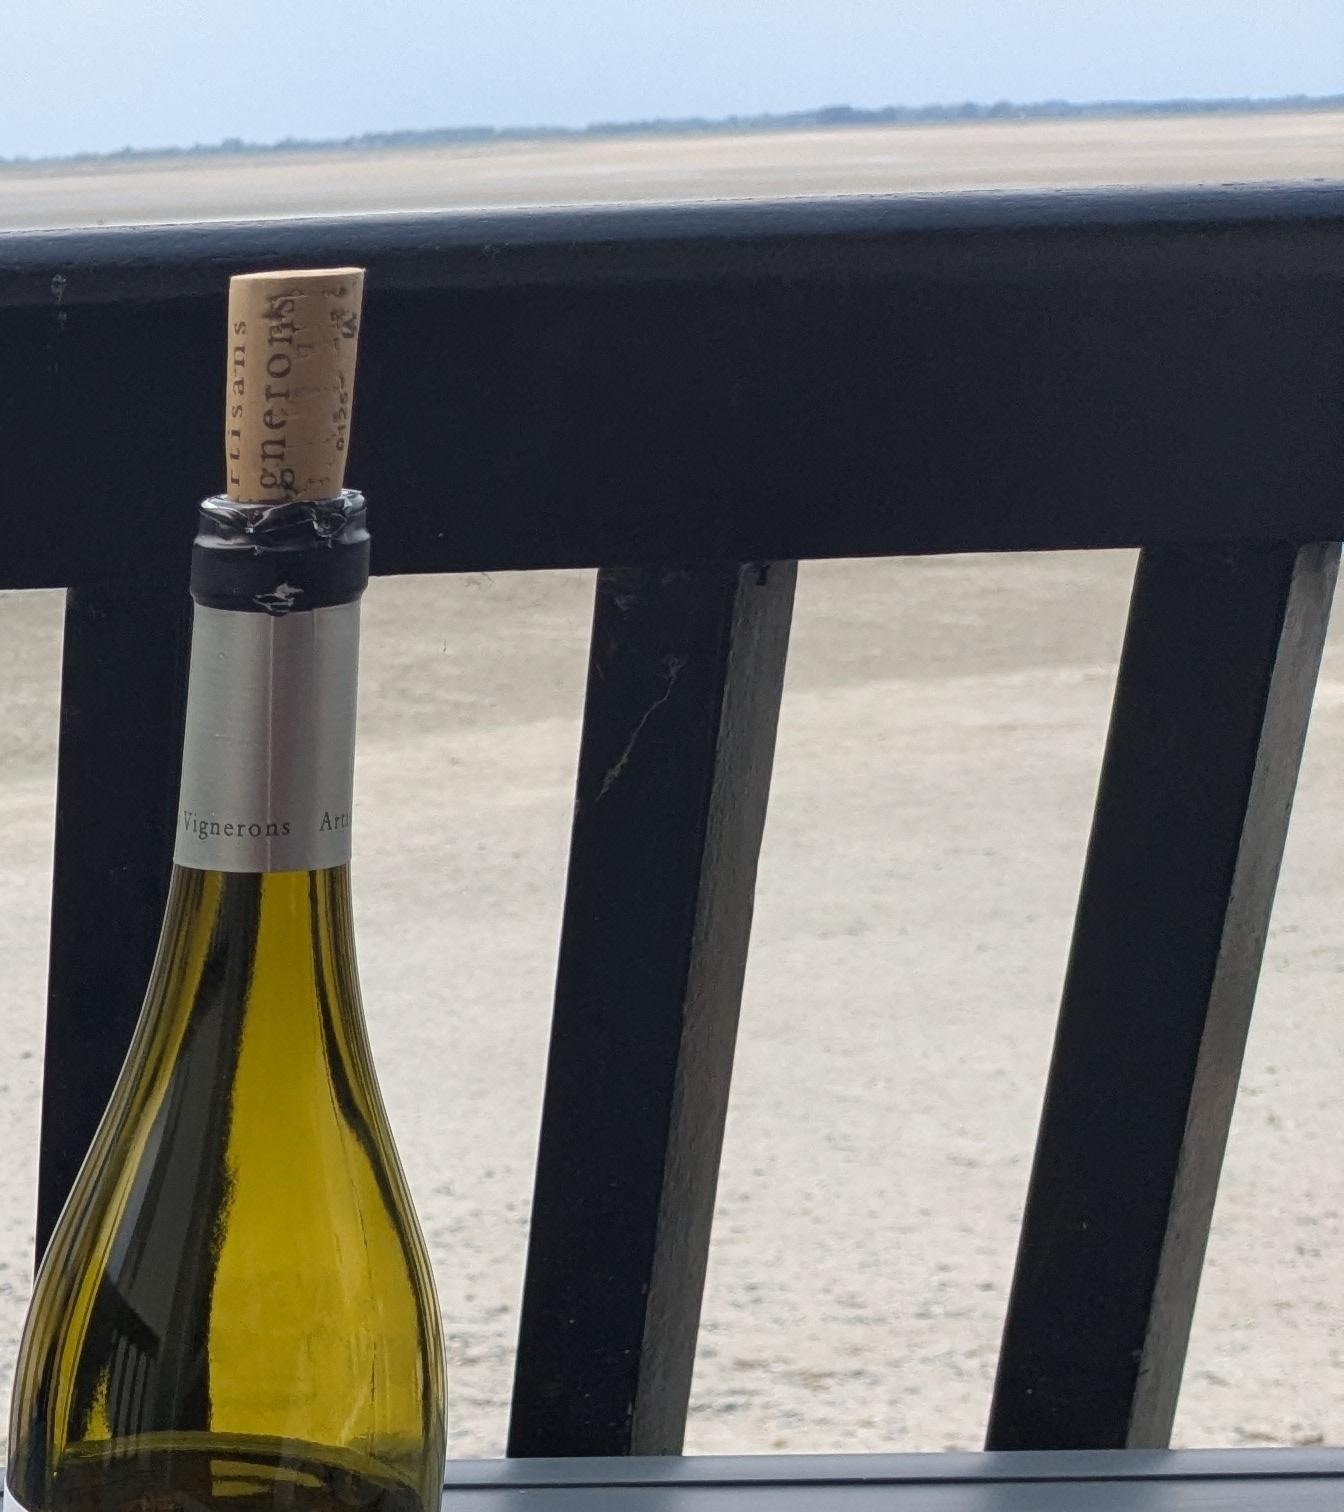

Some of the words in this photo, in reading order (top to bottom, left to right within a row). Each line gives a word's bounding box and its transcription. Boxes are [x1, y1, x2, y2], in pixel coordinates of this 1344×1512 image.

[229, 321, 247, 488] rtisans
[260, 297, 296, 492] gnerons
[183, 810, 291, 840] Vignerons
